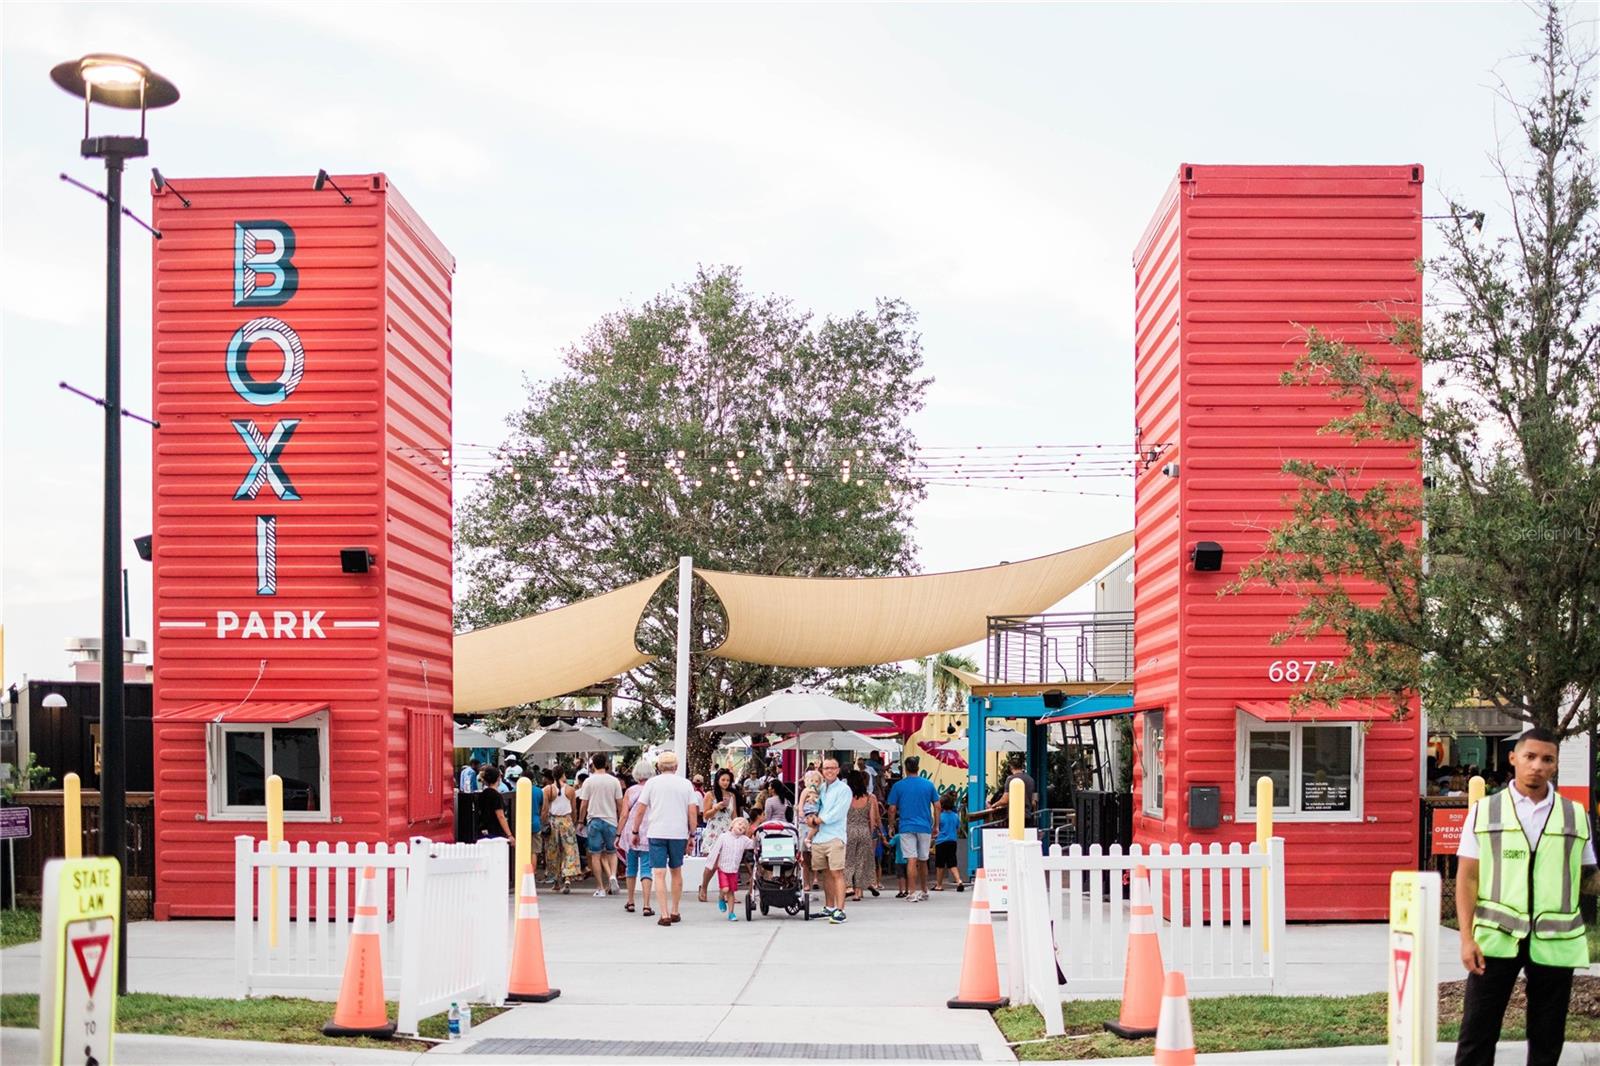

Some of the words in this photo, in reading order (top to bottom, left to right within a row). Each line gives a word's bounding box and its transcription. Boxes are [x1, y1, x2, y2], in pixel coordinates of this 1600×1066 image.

[225, 220, 306, 597] BOXI
[216, 610, 327, 640] PARK
[1268, 660, 1335, 683] 6877
[1503, 849, 1526, 859] SECURITY
[73, 869, 111, 890] STATE
[79, 893, 105, 914] LAW
[84, 1020, 97, 1036] TO
